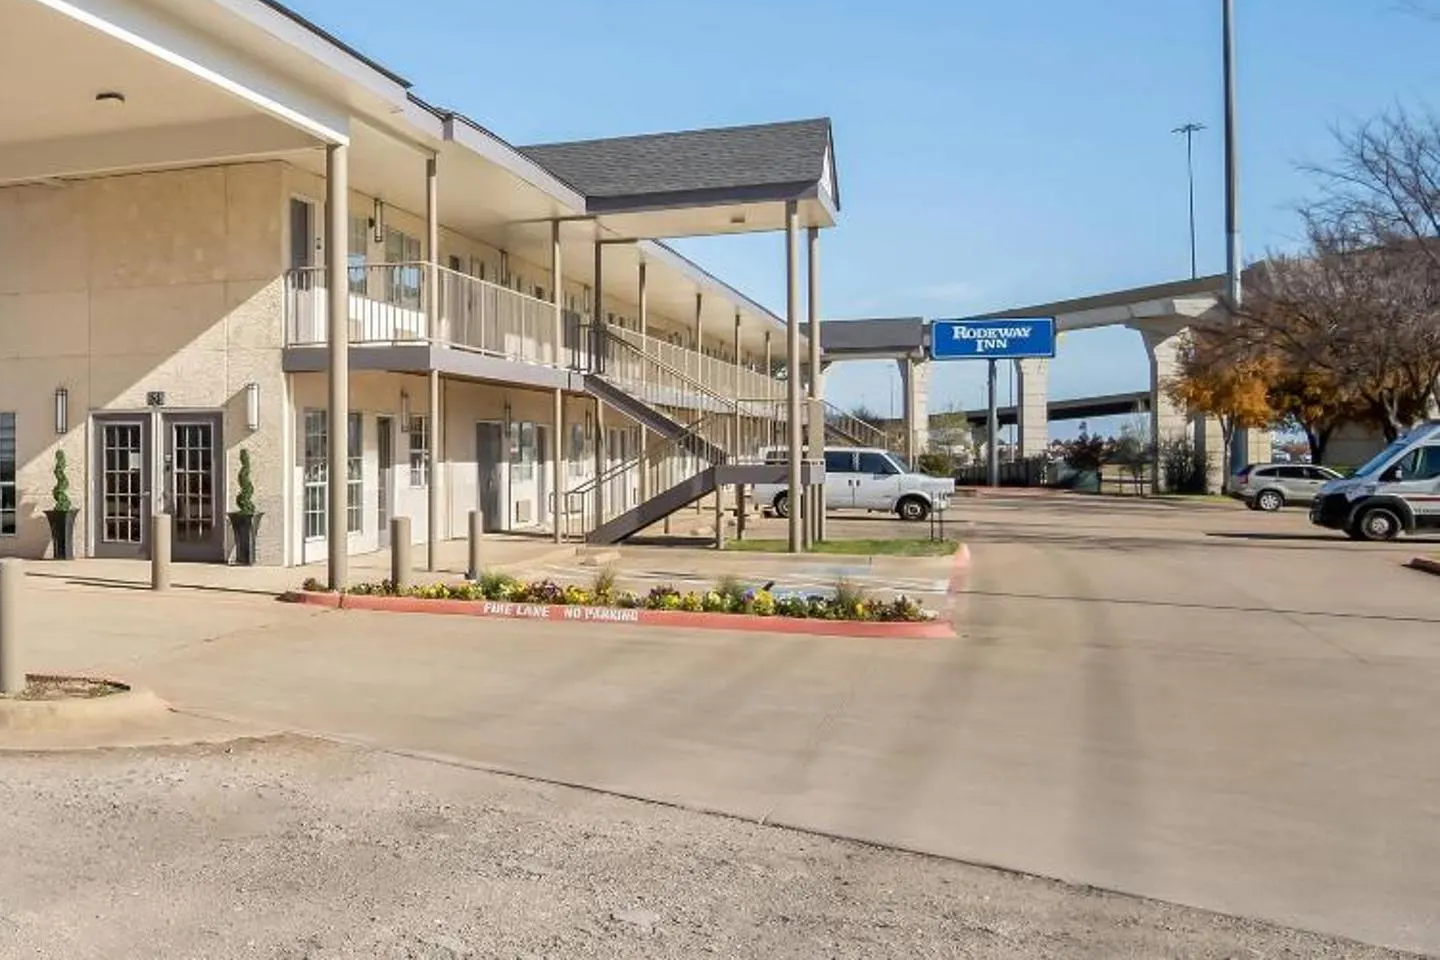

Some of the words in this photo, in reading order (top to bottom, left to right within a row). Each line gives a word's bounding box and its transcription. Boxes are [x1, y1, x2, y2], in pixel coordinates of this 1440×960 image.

[952, 326, 1032, 339] RODEWAY
[976, 339, 1007, 352] INN
[483, 602, 512, 616] FIRE
[516, 604, 549, 618] LANE
[563, 606, 581, 619] NO
[585, 607, 639, 621] PARKING
